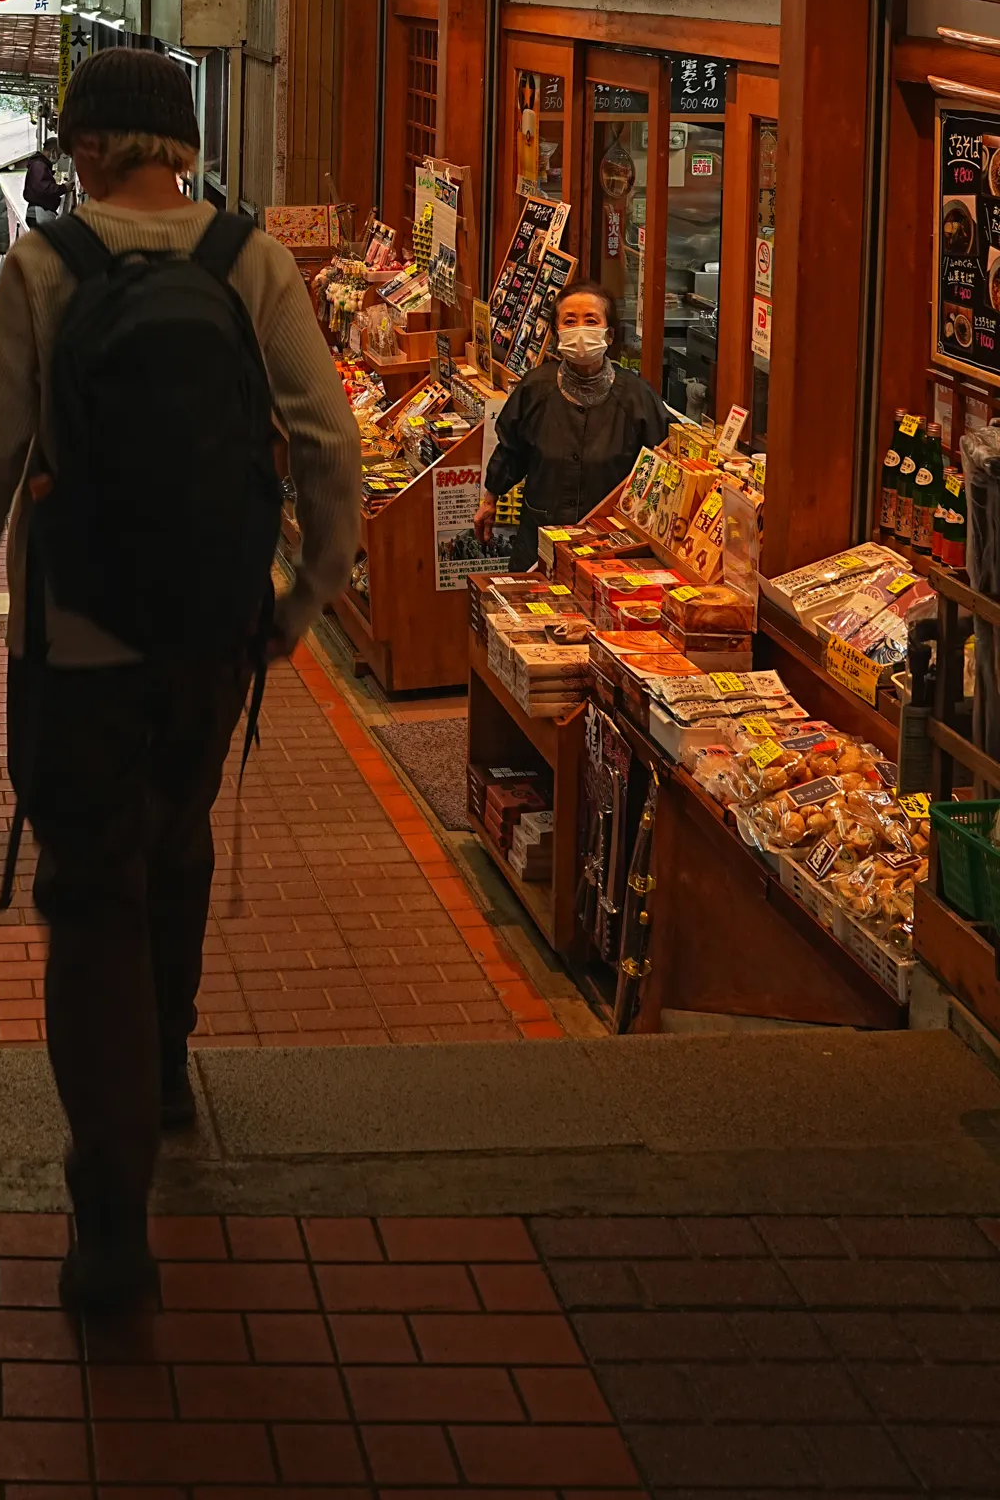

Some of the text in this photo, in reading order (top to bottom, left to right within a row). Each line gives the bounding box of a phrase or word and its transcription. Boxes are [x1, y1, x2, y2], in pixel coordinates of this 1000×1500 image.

[680, 97, 719, 109] 500 400
[948, 133, 983, 158] ざるそば
[607, 212, 620, 250] 消火器
